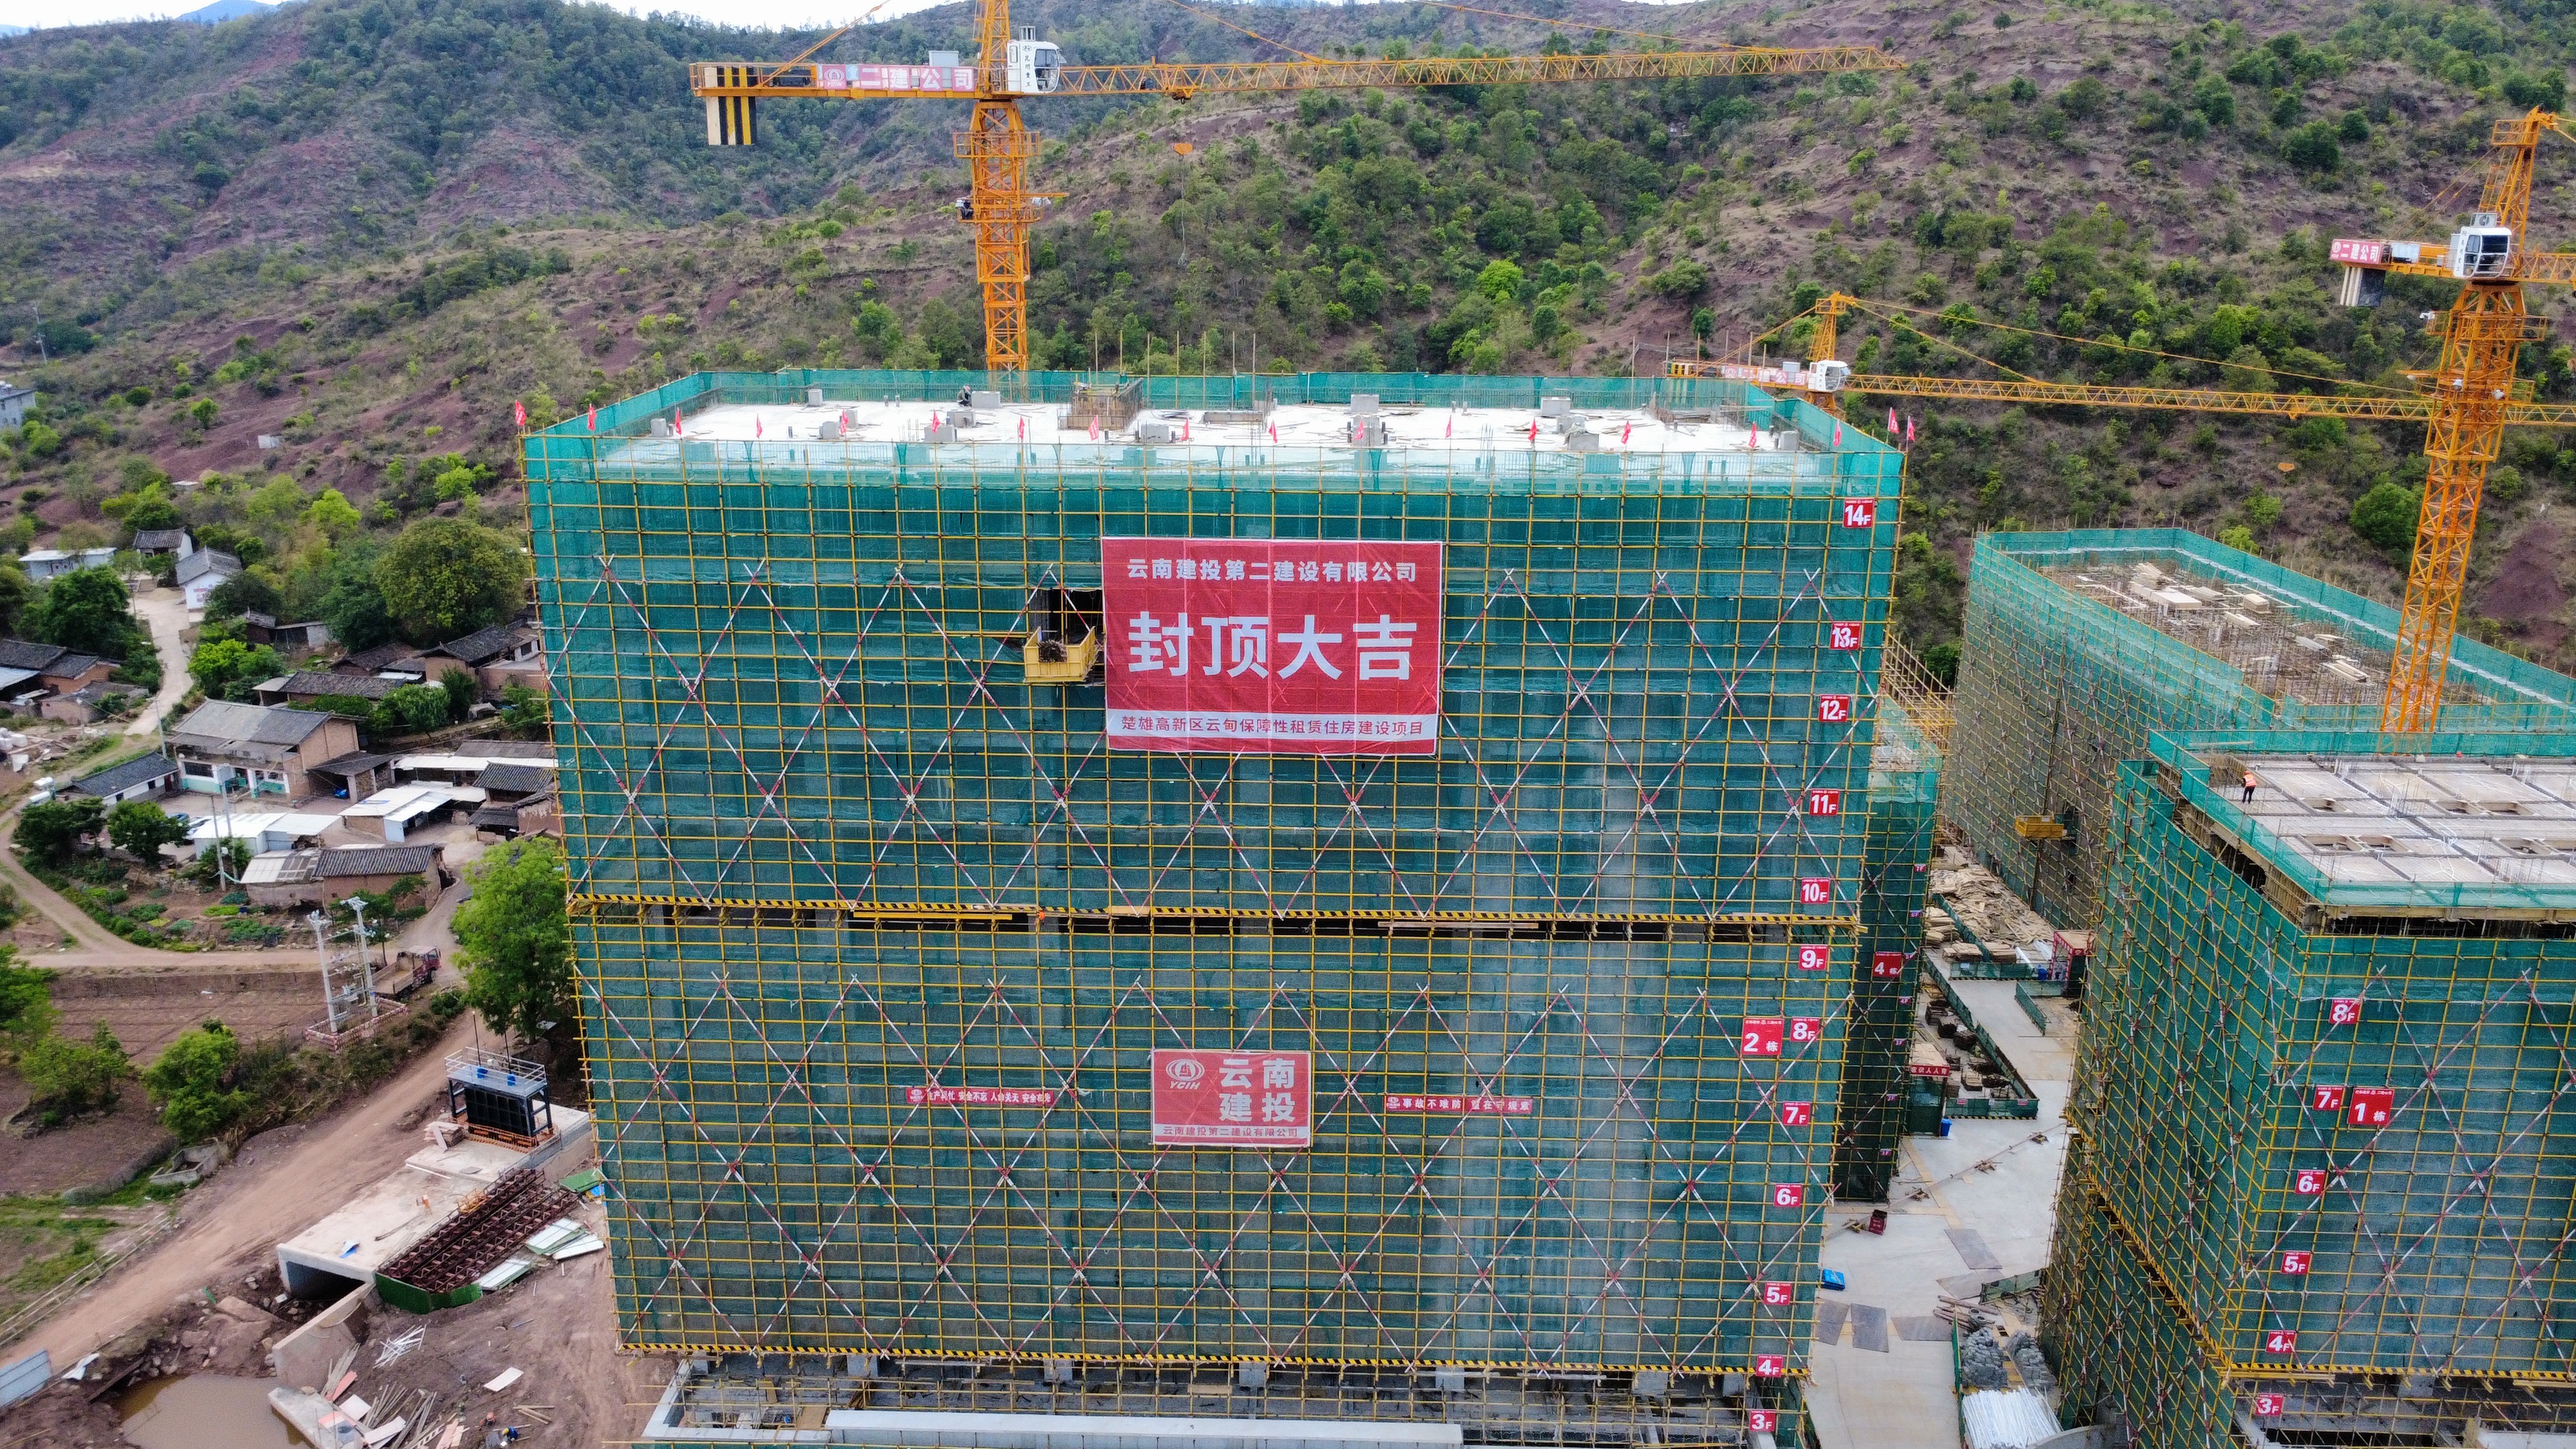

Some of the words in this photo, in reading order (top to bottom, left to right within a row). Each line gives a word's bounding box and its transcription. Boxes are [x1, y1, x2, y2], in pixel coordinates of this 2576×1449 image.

[861, 67, 972, 90] 二建公司
[2340, 243, 2380, 261] 二建公司
[1844, 504, 1871, 526] 14F
[1127, 557, 1416, 583] 云南建投第二建设有限公司
[1128, 611, 1417, 681] 封顶大吉
[1832, 626, 1858, 649] 13F
[1821, 699, 1846, 720] 12F
[1121, 715, 1423, 736] 楚雄高新区云甸保障性租赁住房建设项目
[1811, 793, 1837, 814] 11F
[1803, 882, 1828, 902] 10F
[1801, 950, 1824, 969] 9F
[1875, 961, 1885, 975] 4
[2332, 1004, 2356, 1022] 8F
[1792, 1022, 1815, 1041] 8F
[1744, 1032, 1759, 1052] 2
[1218, 1057, 1296, 1089] 云南
[1169, 1081, 1201, 1090] YCIH
[1218, 1092, 1296, 1122] 建投
[2317, 1091, 2339, 1109] 7F
[1785, 1106, 1806, 1124] 7F
[2354, 1103, 2366, 1122] 1
[1162, 1126, 1298, 1138] 云南建投第二建设有限公司
[2298, 1175, 2320, 1193] 6F
[1776, 1188, 1799, 1206] 6F
[2284, 1256, 2306, 1273] 5F
[1766, 1286, 1788, 1303] 5F
[2268, 1335, 2290, 1352] 4F
[1758, 1359, 1779, 1376] 4F
[2257, 1397, 2279, 1414] 3F
[1751, 1414, 1772, 1430] 3F
